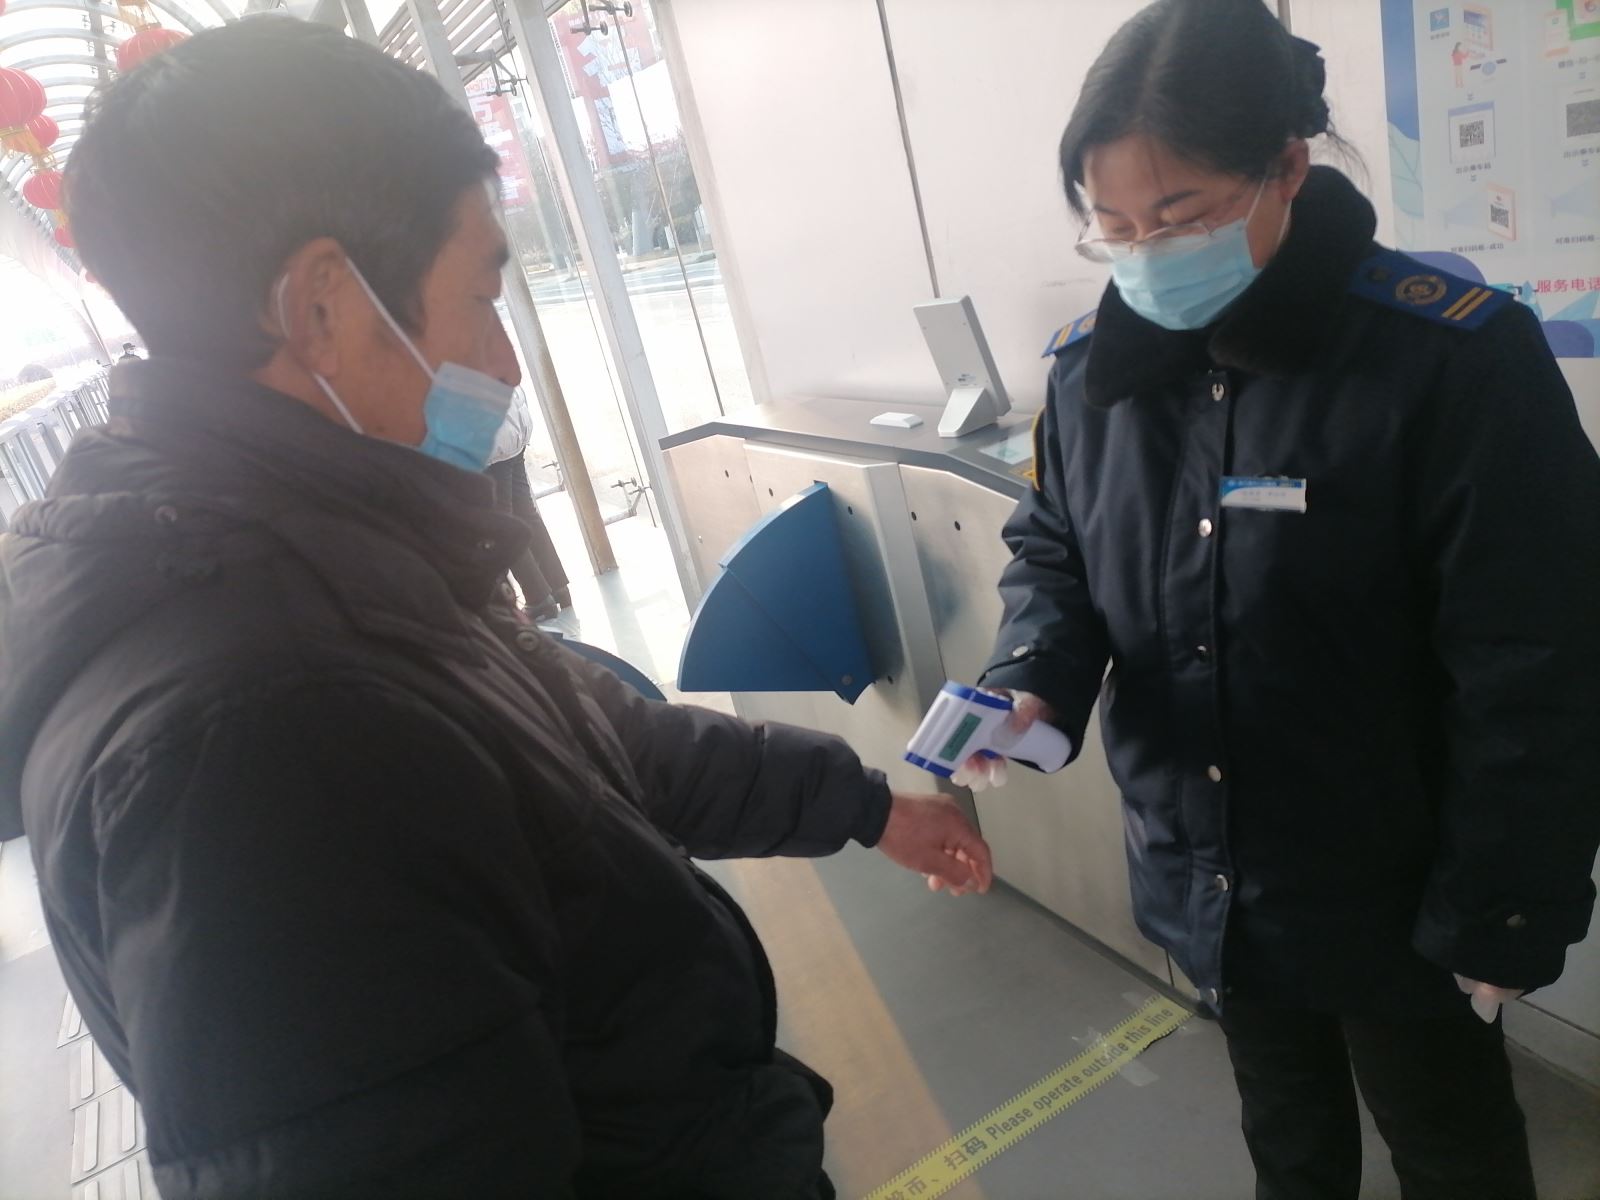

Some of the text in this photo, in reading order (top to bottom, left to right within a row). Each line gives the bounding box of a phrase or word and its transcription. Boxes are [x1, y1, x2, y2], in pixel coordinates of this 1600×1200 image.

[986, 1106, 1034, 1141] Please
[1033, 1074, 1083, 1111] operate
[1082, 1042, 1130, 1077] outside
[1124, 1024, 1152, 1044] this
[1144, 1008, 1174, 1028] line
